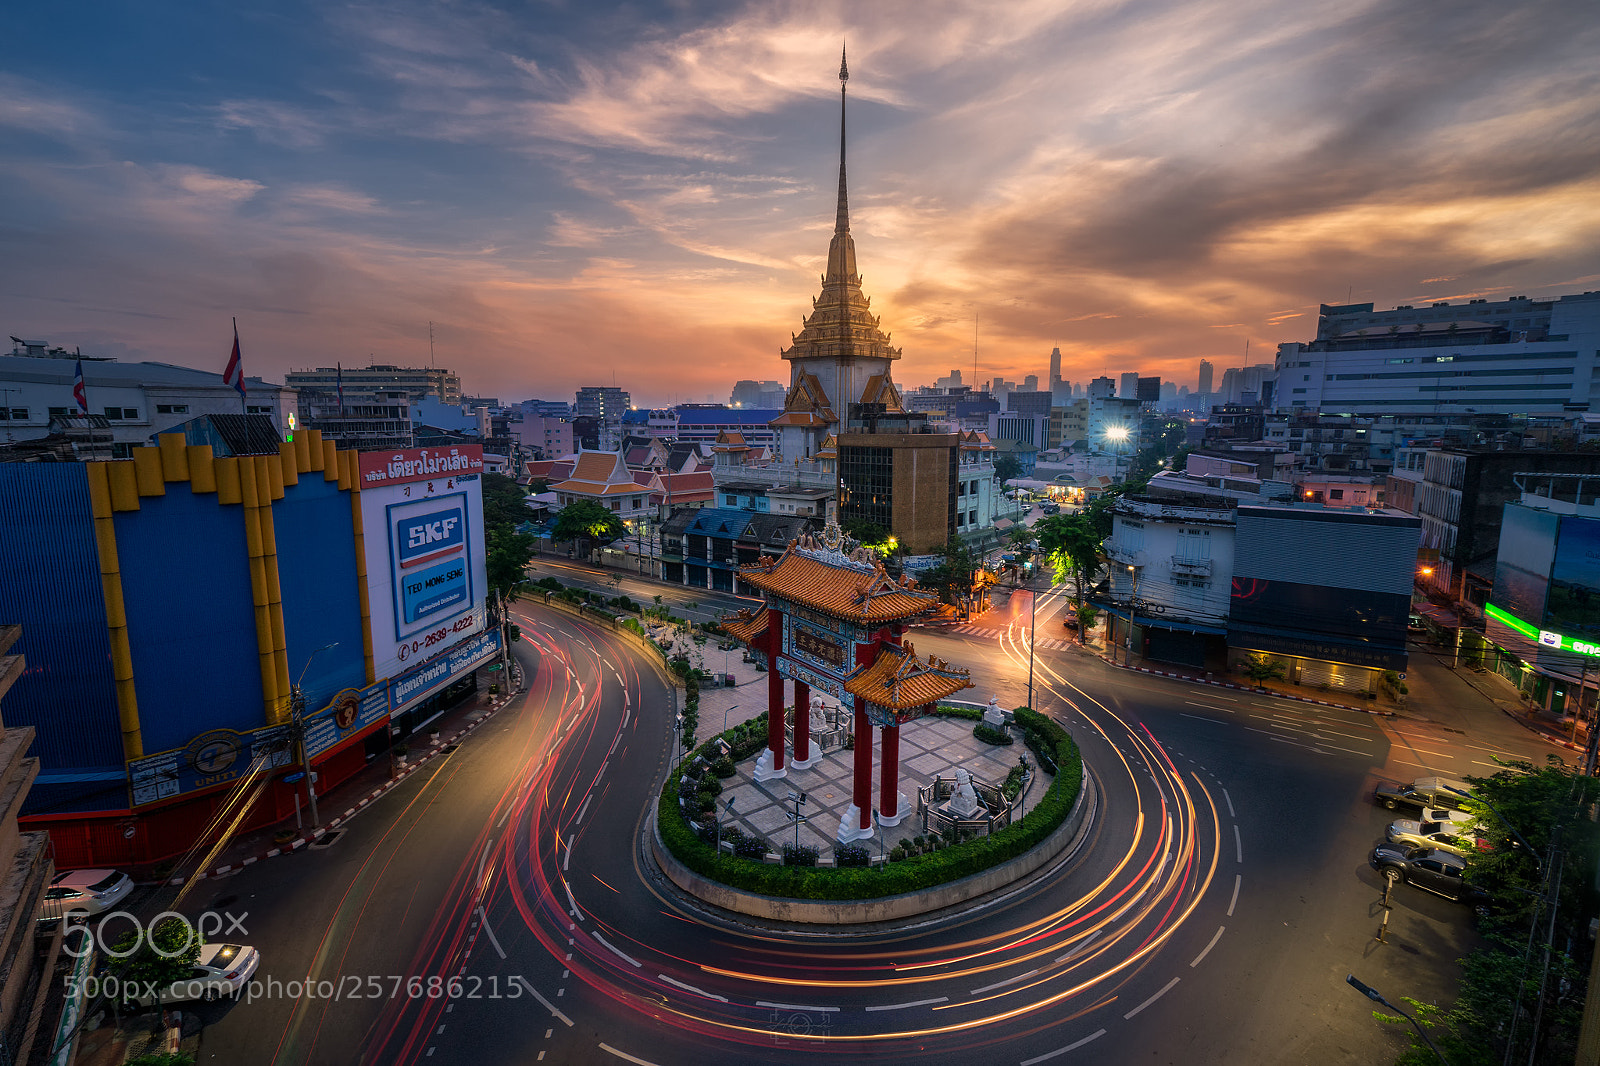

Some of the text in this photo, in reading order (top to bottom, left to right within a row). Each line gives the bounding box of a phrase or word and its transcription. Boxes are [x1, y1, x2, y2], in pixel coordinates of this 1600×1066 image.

[408, 517, 458, 549] SKF
[407, 568, 463, 595] TEO MONG SENG
[440, 593, 460, 606] Distributor
[412, 615, 474, 653] 0-2639-4222
[195, 770, 238, 787] UNITY
